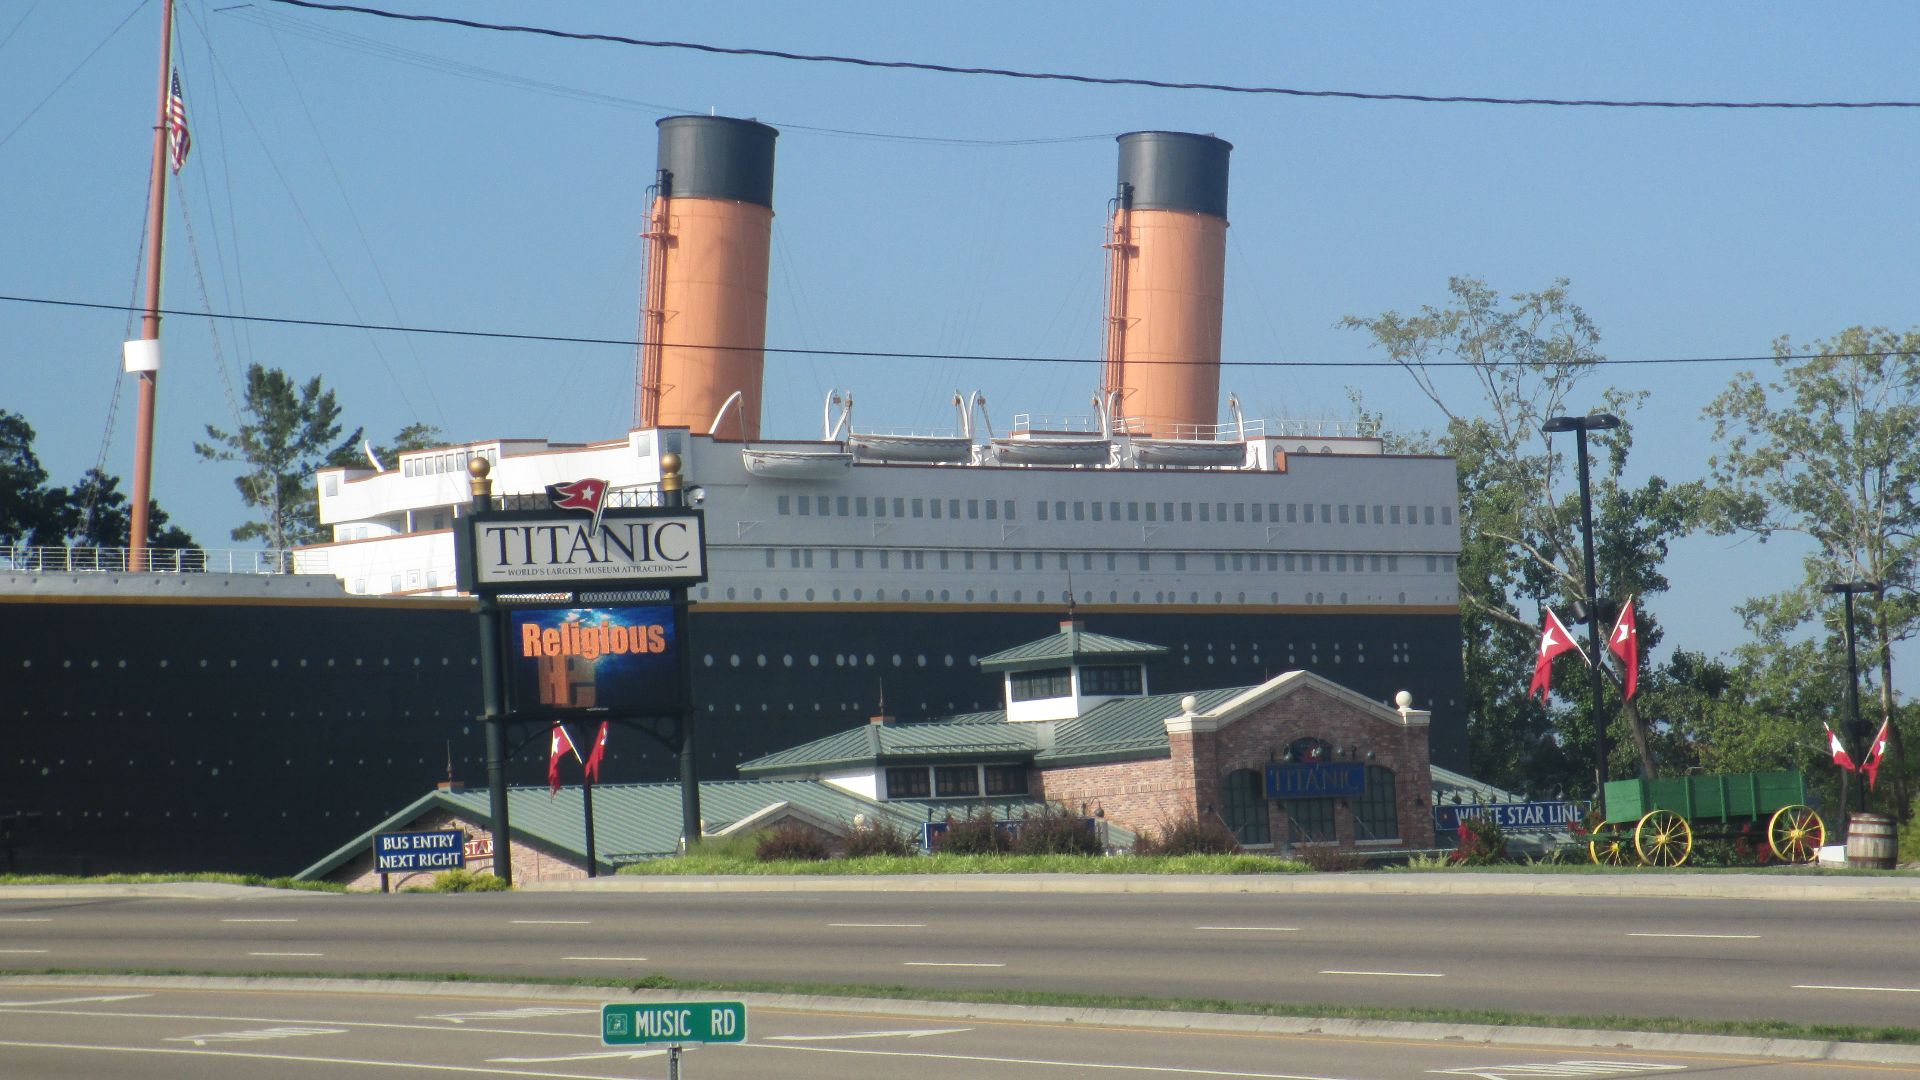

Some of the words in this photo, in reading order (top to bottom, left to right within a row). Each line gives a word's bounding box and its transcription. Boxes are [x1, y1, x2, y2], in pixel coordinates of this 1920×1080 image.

[486, 522, 689, 566] TITANIC
[507, 567, 545, 577] WORLD'S
[546, 566, 583, 576] LARGEST
[584, 565, 620, 575] MUSEUM
[622, 564, 673, 574] ATTRACTION
[522, 622, 666, 661] Religious
[1268, 766, 1361, 792] TITANIC
[1507, 805, 1546, 825] STAR
[1549, 804, 1583, 823] LINE
[383, 836, 410, 851] BUS
[413, 834, 455, 849] ENTRY
[379, 854, 416, 869] NEXT
[419, 852, 461, 867] RIGHT
[635, 1010, 692, 1038] MUSIC
[711, 1009, 736, 1036] RD
